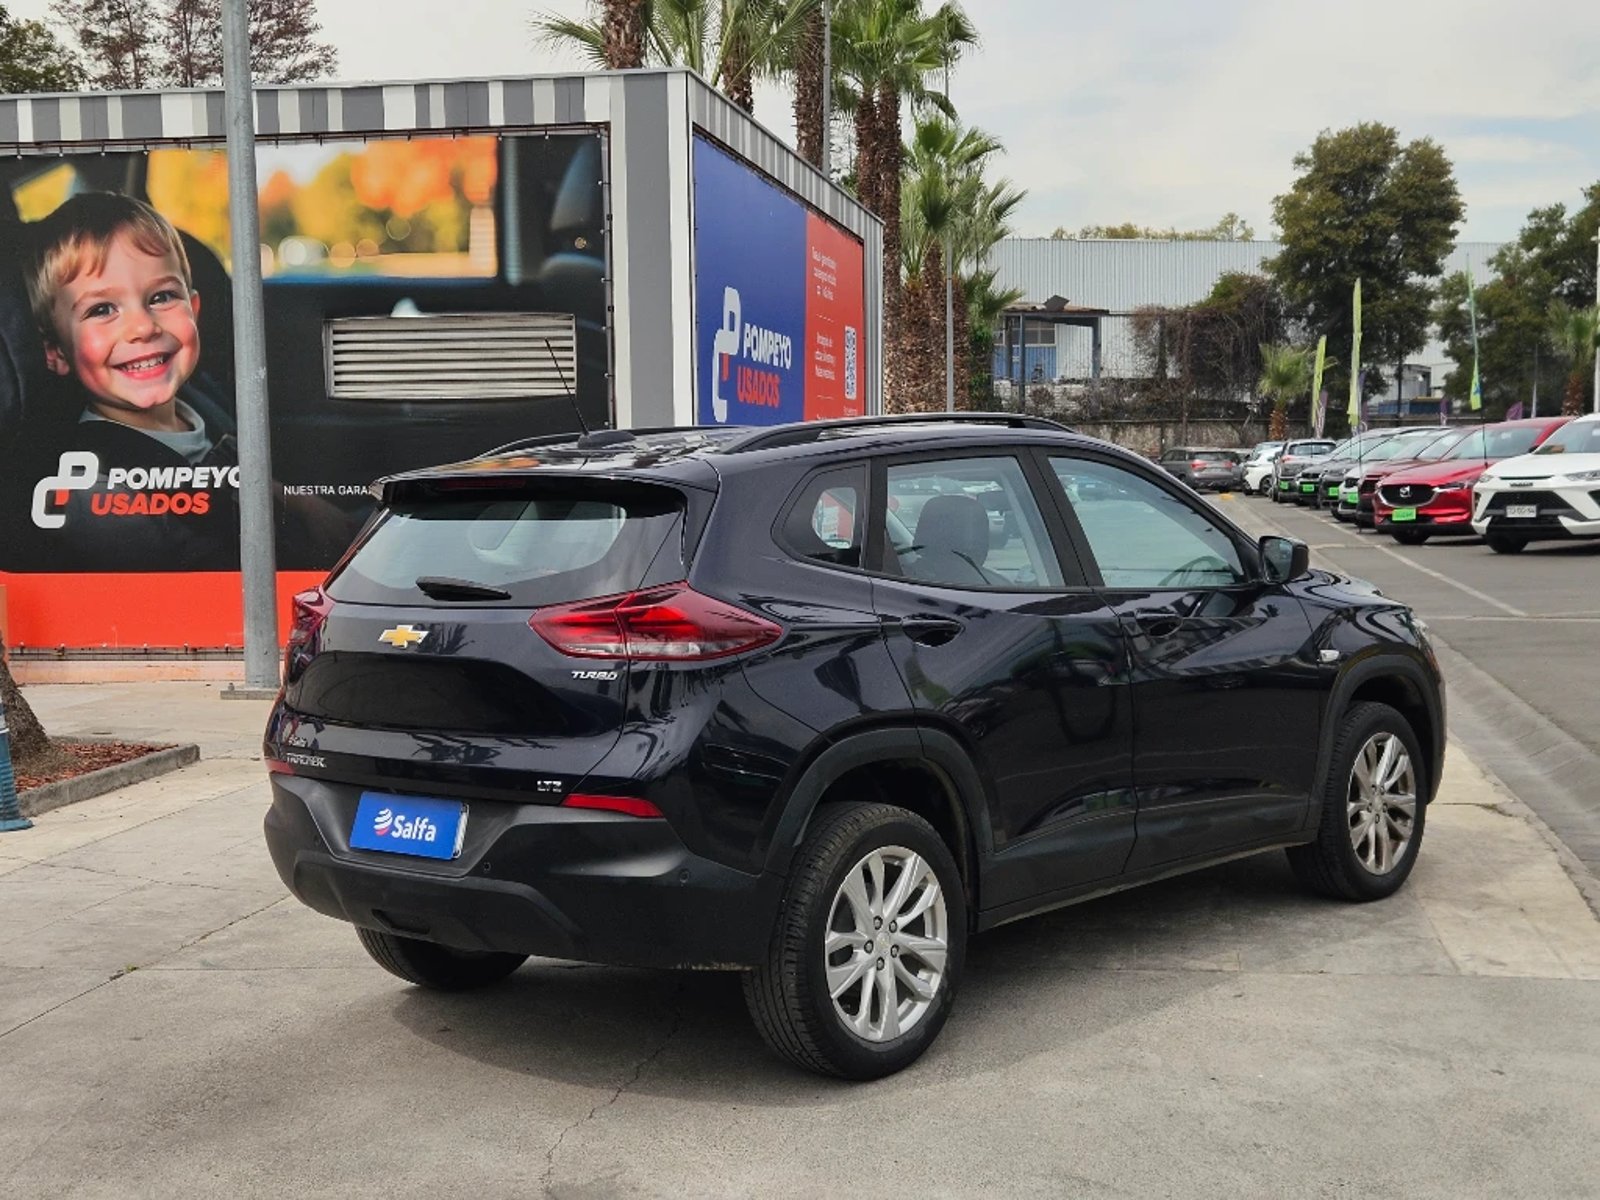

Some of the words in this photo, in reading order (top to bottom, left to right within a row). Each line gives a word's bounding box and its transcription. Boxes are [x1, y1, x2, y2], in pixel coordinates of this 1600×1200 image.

[743, 323, 792, 369] POMPEYO
[737, 366, 781, 408] USADOS
[283, 485, 335, 495] NUESTRA
[91, 492, 209, 515] USADOS
[571, 670, 618, 680] TURBO
[391, 815, 437, 842] Salfa
